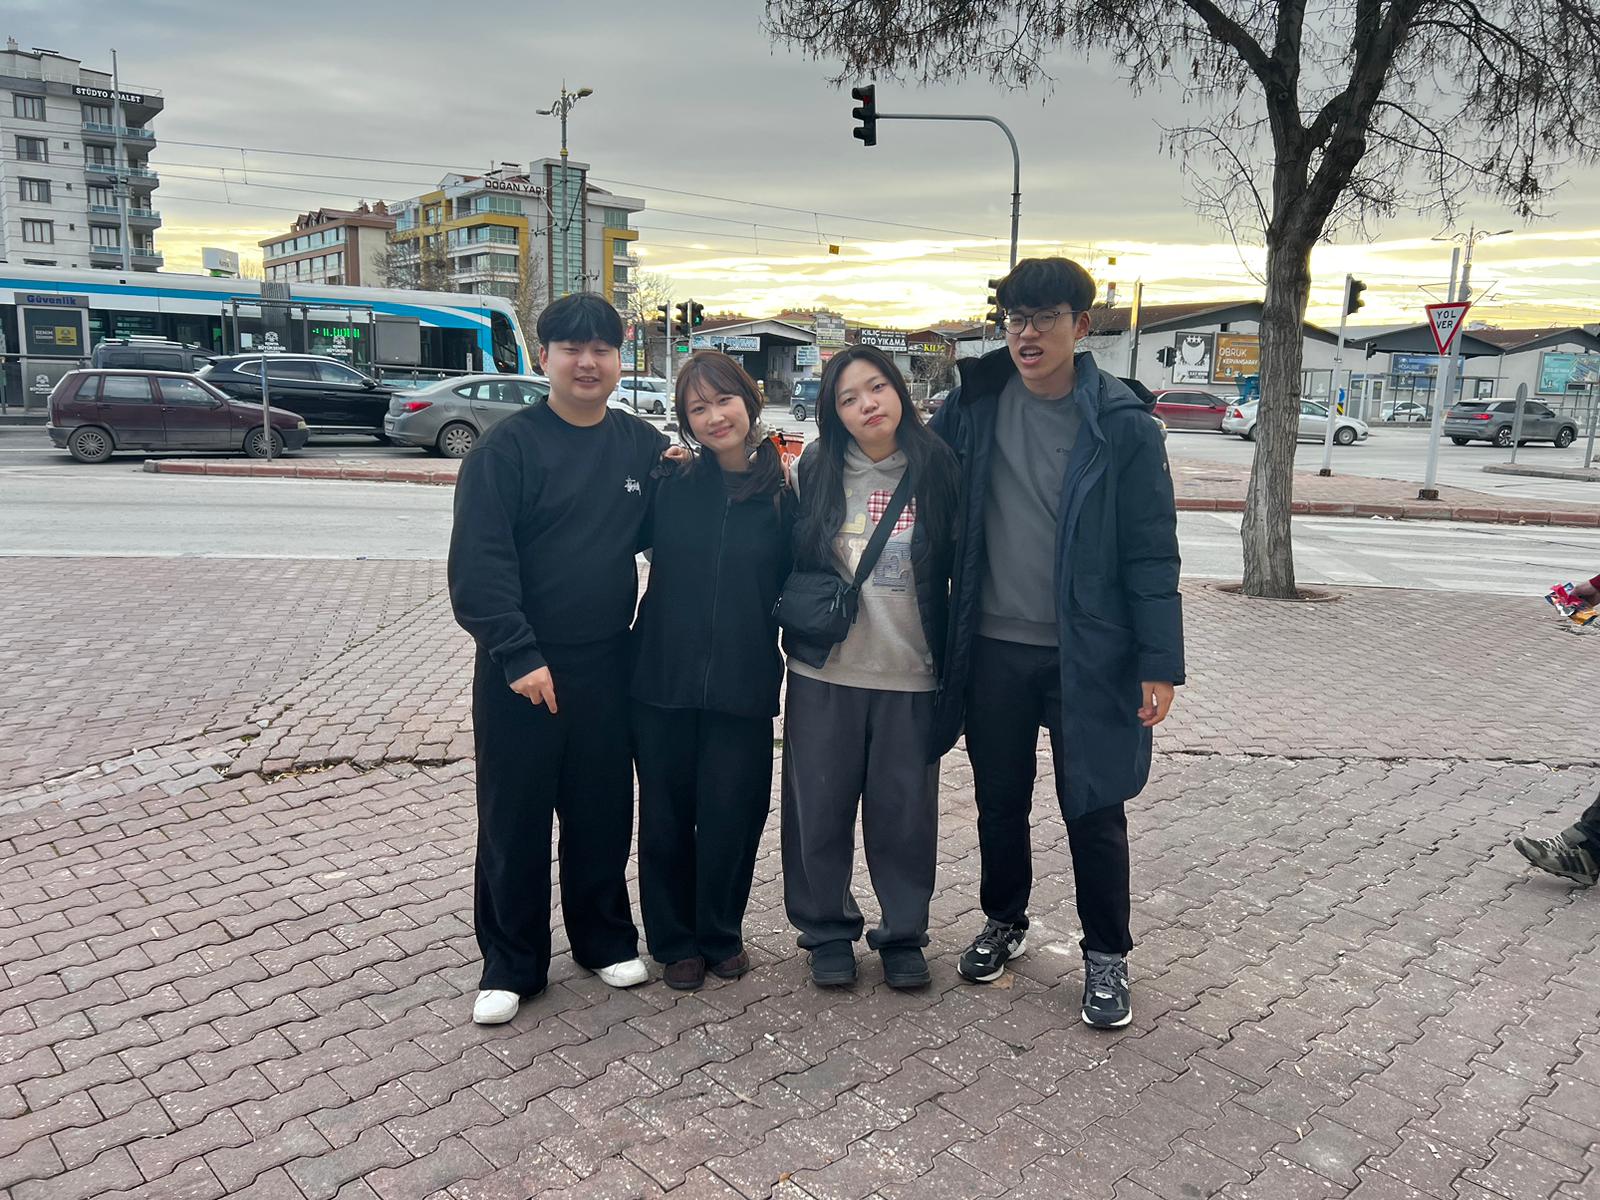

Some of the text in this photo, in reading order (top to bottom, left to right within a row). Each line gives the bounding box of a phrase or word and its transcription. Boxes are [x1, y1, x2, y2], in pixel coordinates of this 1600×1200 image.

[75, 87, 108, 98] STÜDYO
[26, 294, 77, 305] Güvenlik
[1437, 310, 1457, 319] YOL
[1437, 320, 1453, 329] VER
[861, 337, 907, 346] OTO YIKAMA
[1218, 347, 1248, 358] OBRUK
